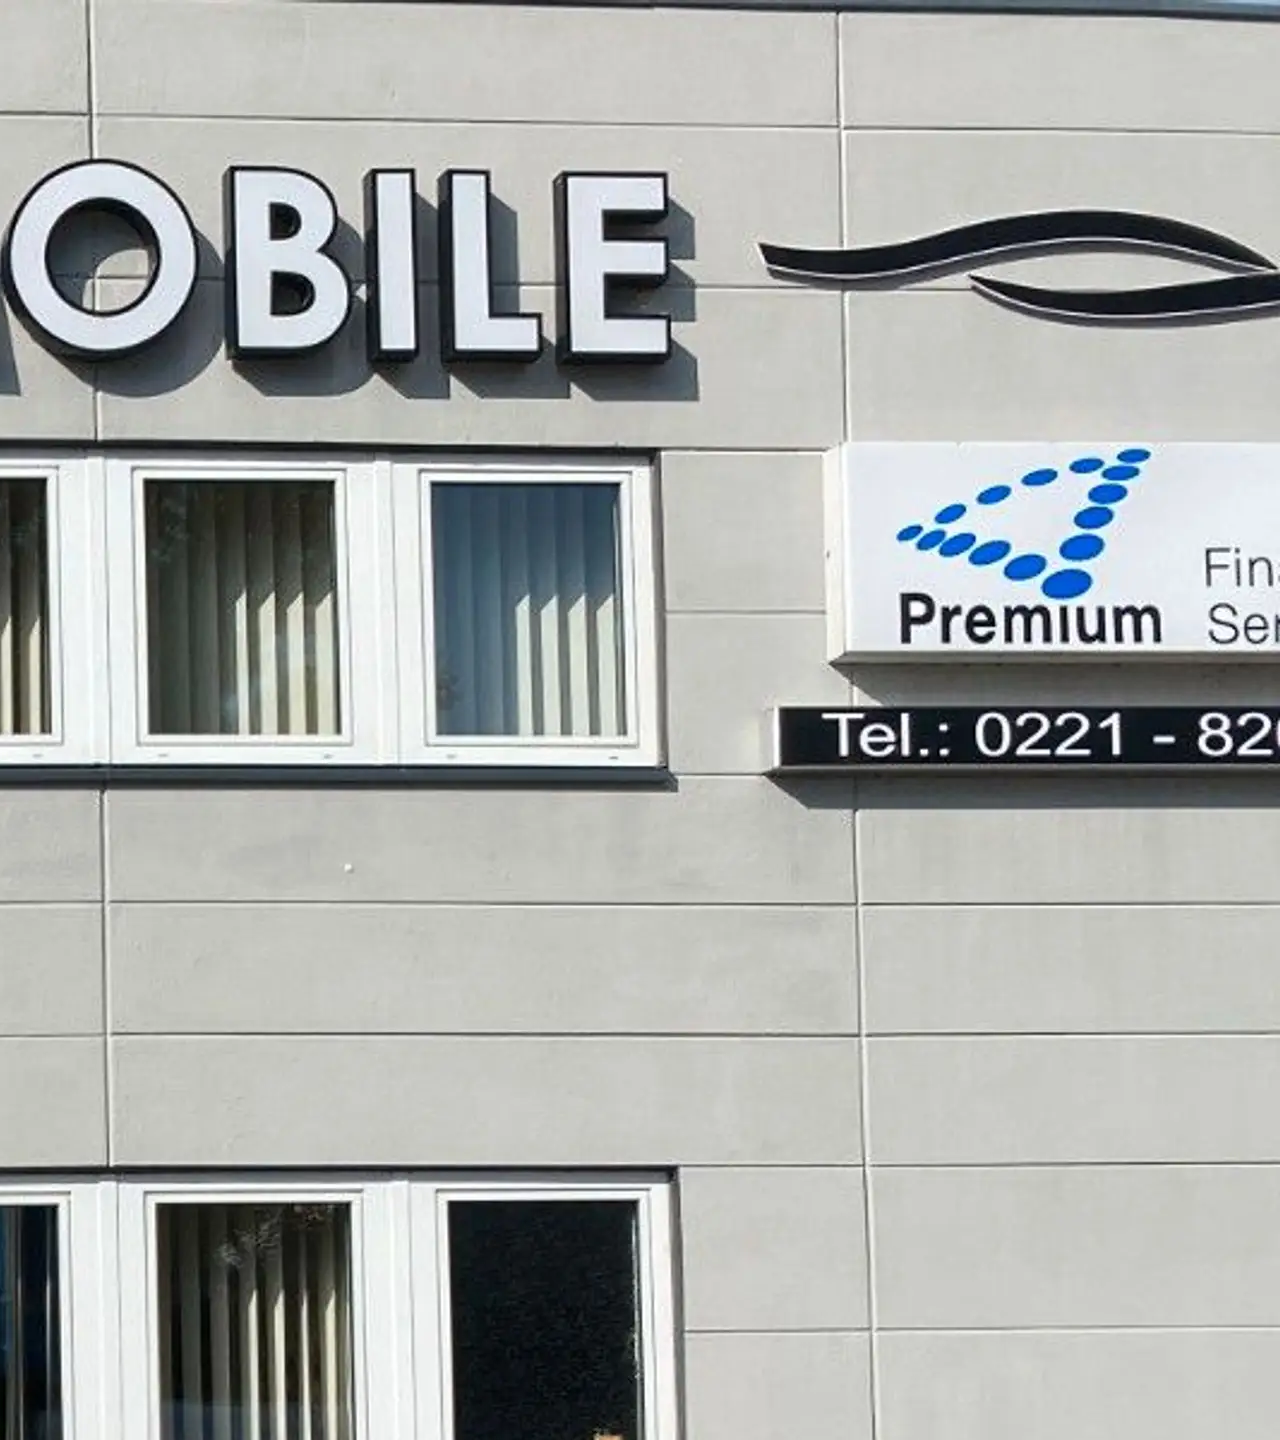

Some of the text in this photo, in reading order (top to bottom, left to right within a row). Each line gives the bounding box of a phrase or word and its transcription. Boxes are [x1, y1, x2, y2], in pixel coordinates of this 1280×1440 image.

[1205, 547, 1280, 587] Fin
[899, 592, 1163, 645] Premium
[821, 712, 949, 757] Tel.:
[974, 711, 1123, 757] 0221
[1198, 711, 1280, 757] 82
